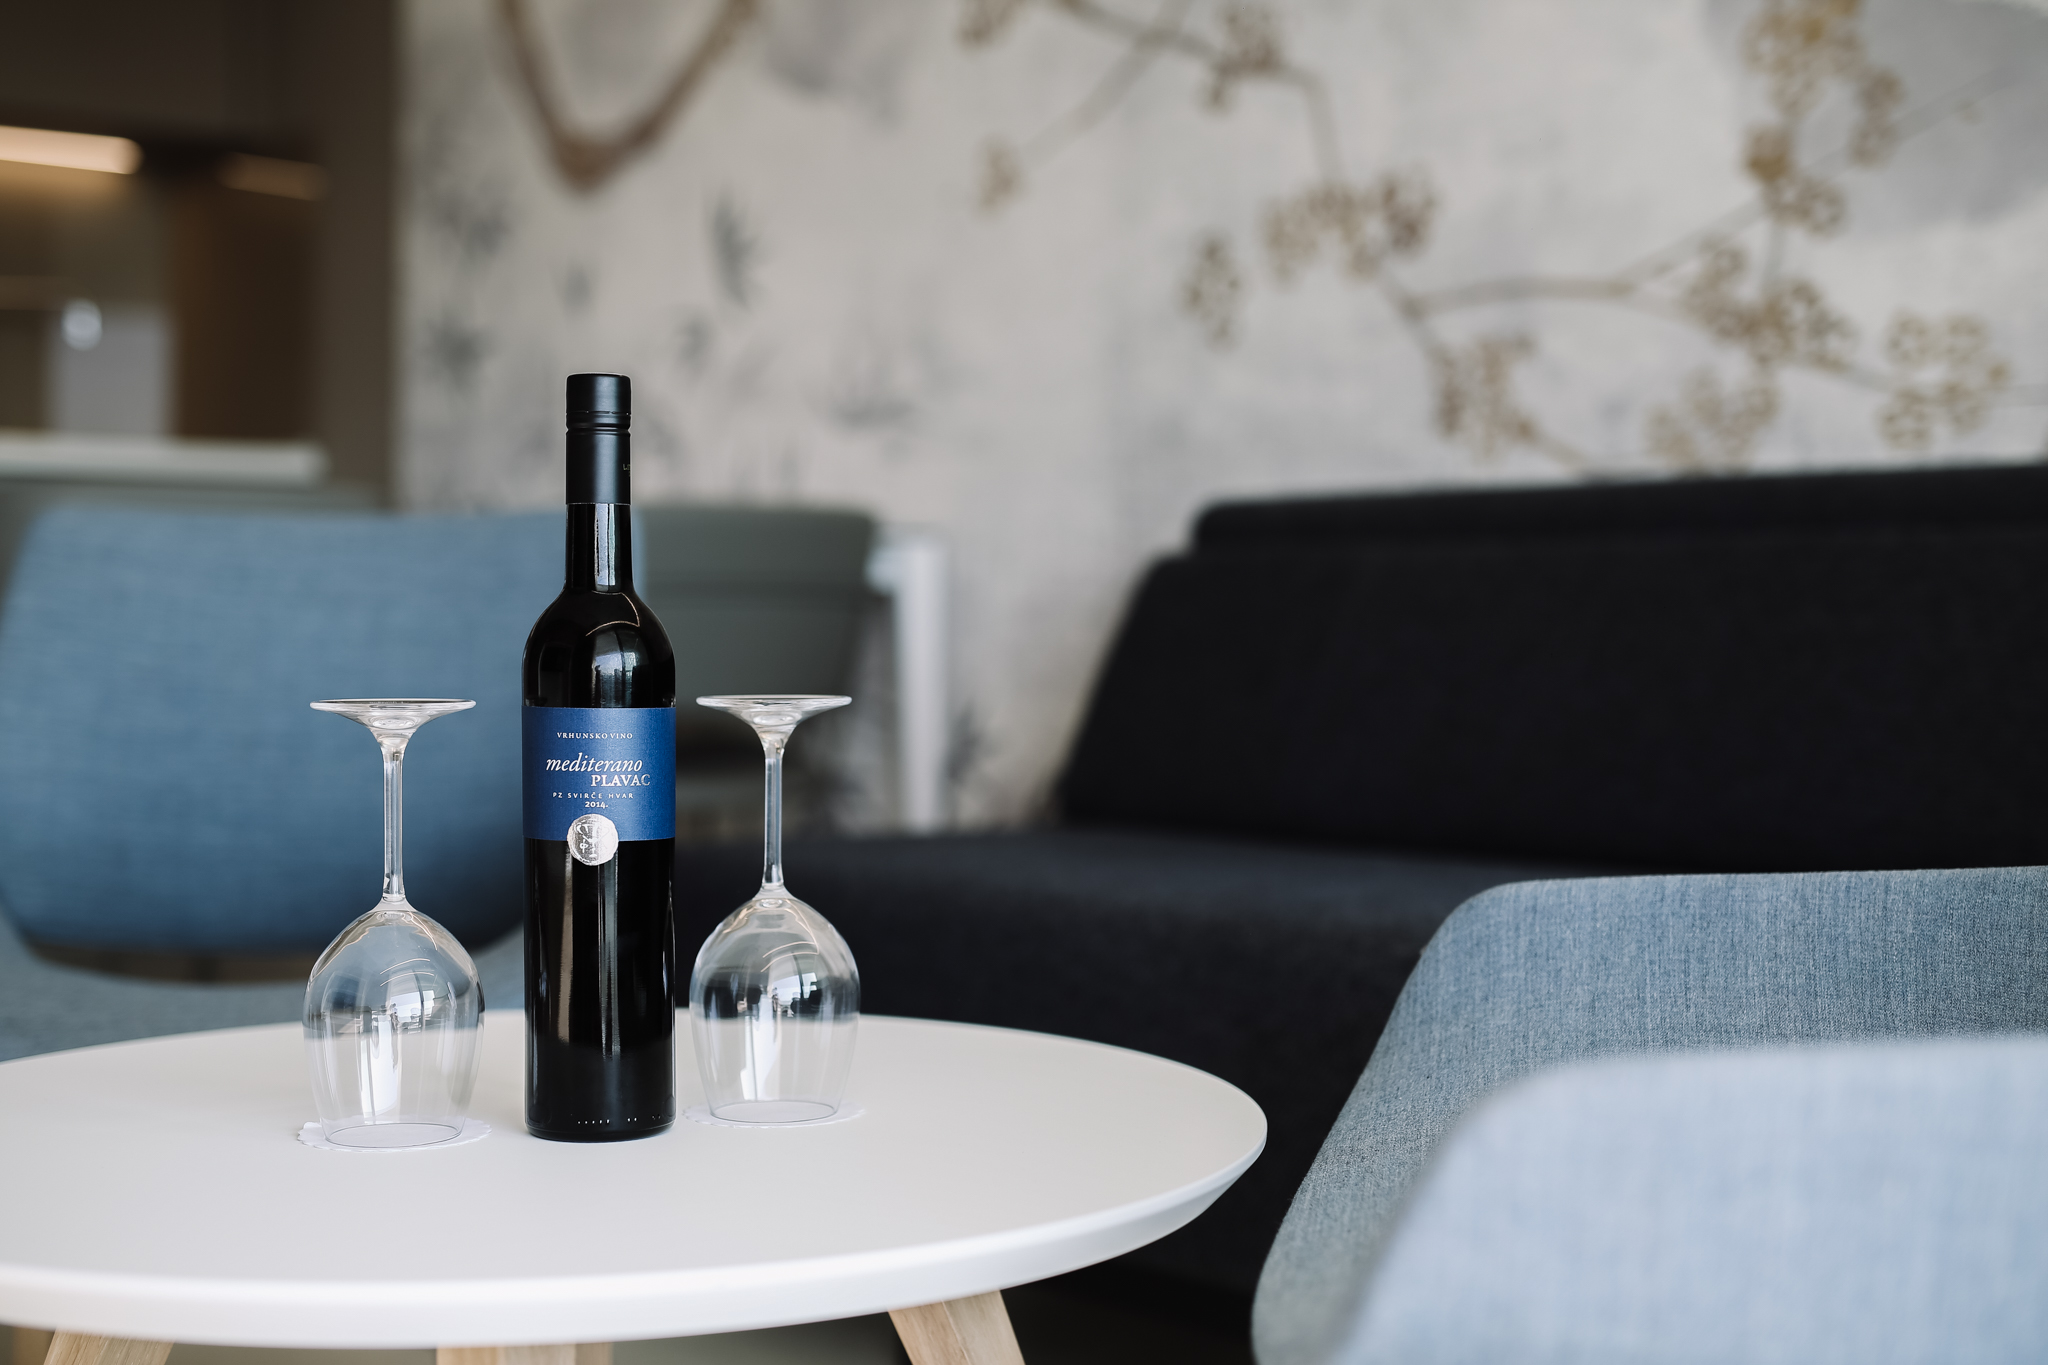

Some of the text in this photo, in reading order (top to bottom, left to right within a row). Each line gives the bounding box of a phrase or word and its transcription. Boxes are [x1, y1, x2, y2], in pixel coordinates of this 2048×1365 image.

[545, 752, 643, 772] mediterano
[591, 774, 650, 787] PLAVAC
[552, 791, 563, 799] PZ
[567, 791, 603, 799] SVIRČE
[584, 801, 609, 809] 2014.
